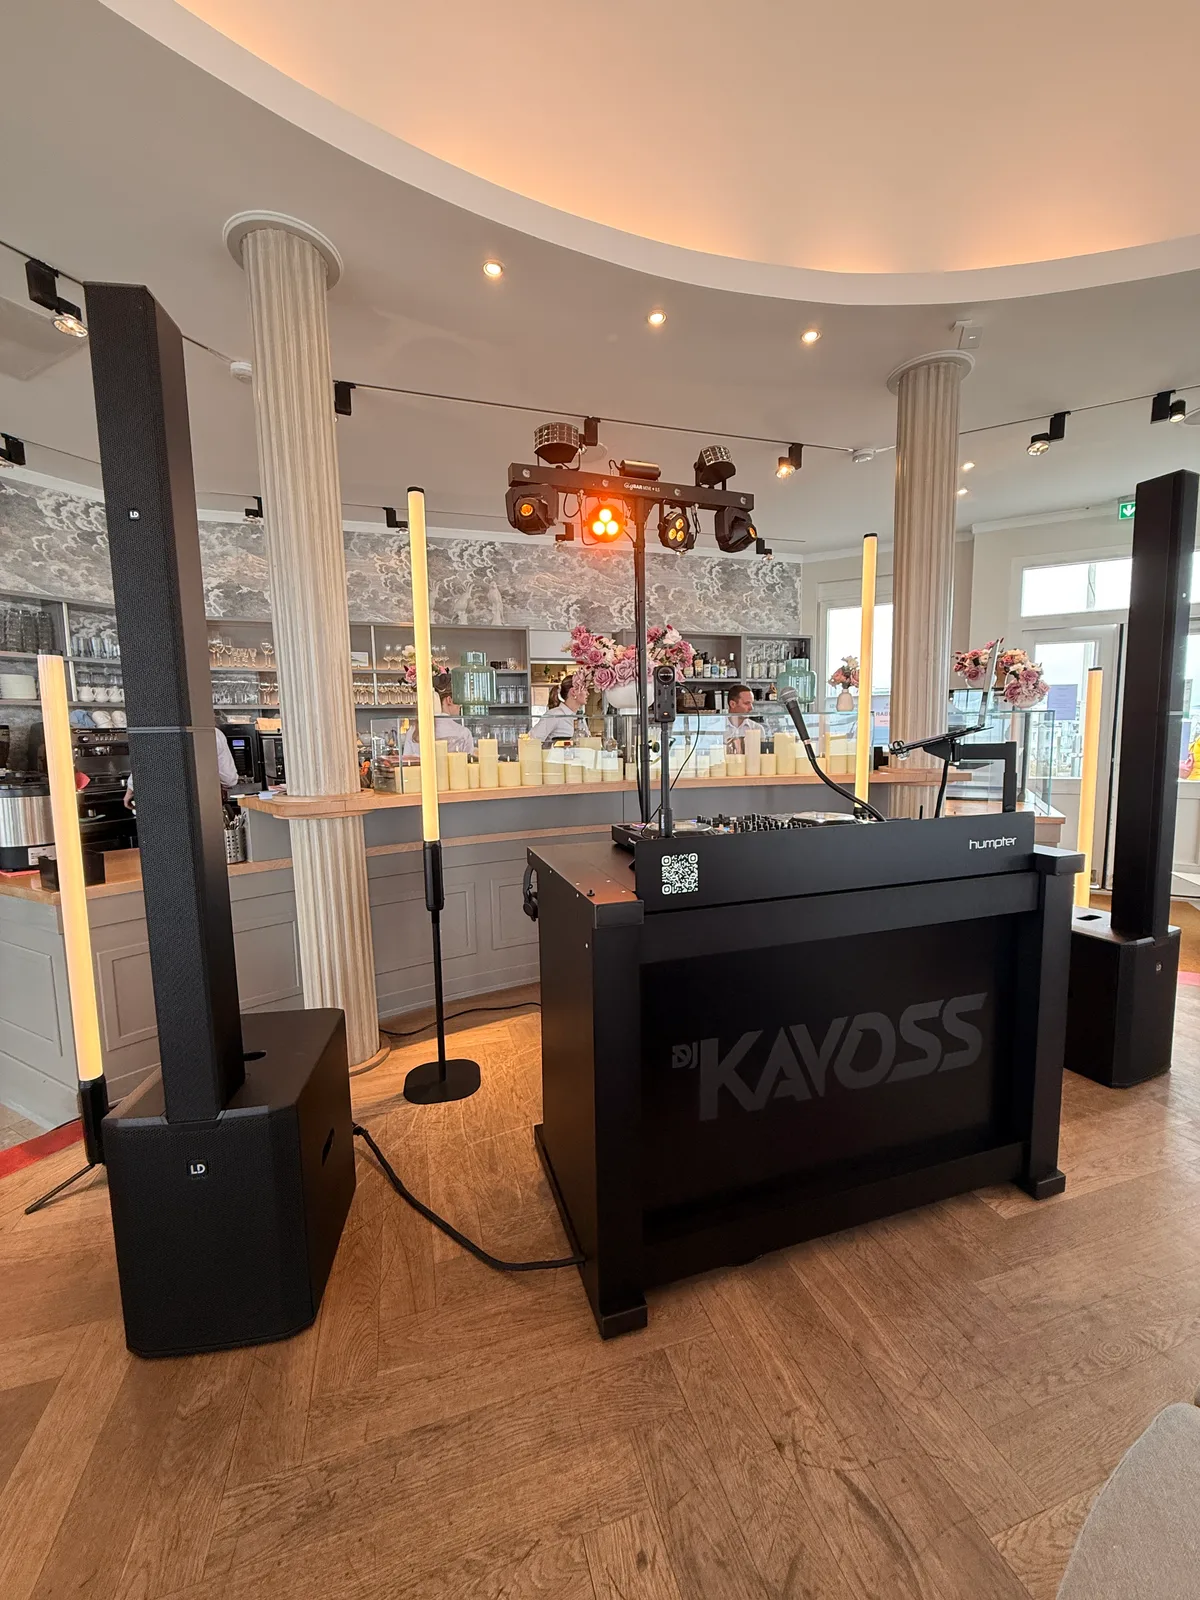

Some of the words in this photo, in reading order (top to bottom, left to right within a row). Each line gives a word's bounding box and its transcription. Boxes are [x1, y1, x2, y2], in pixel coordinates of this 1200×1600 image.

[969, 836, 1017, 849] humpter
[671, 1042, 699, 1069] DJ
[699, 992, 988, 1121] KAYOSS
[190, 1164, 206, 1174] LD
